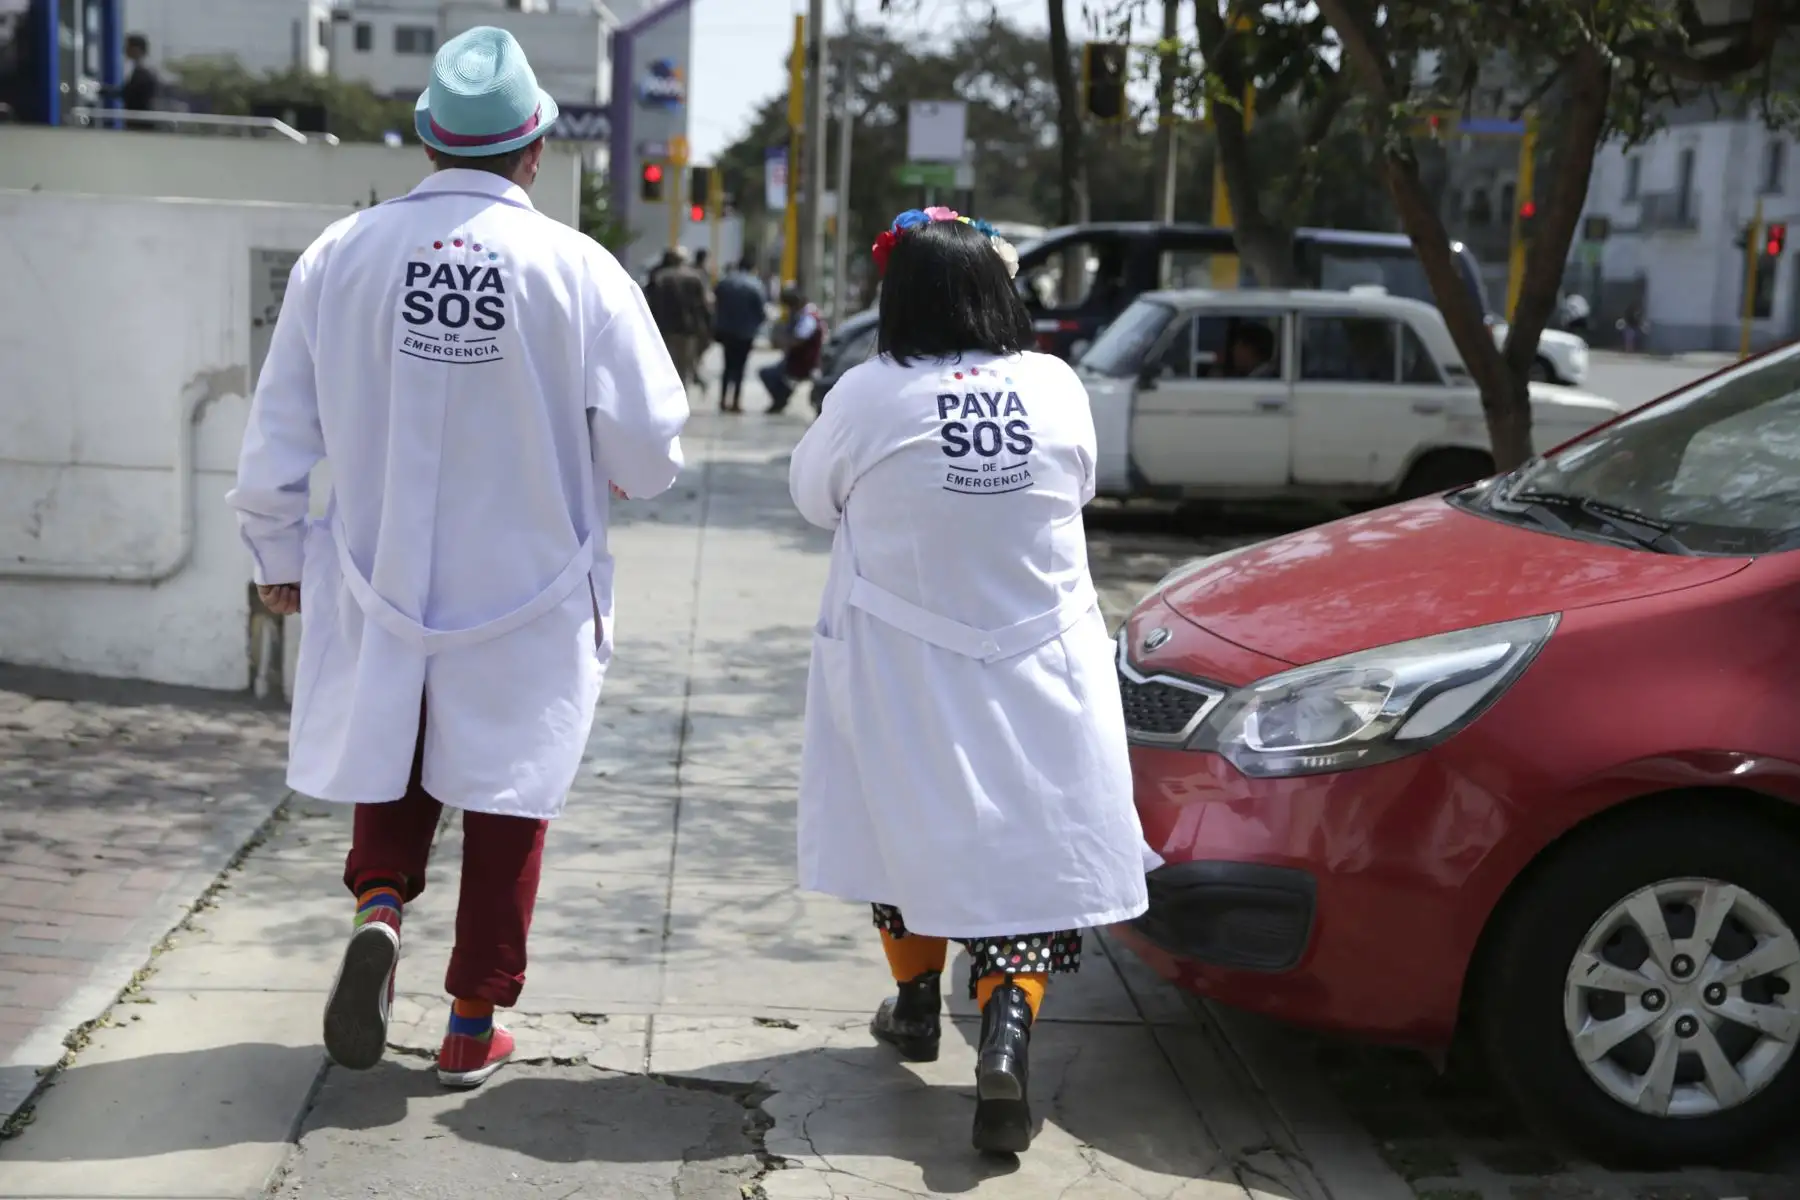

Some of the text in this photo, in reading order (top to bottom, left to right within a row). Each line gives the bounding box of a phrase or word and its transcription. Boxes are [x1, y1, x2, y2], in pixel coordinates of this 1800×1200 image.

[405, 261, 505, 294] PAYA
[402, 290, 505, 331] SOS
[403, 336, 500, 357] EMERGENCIA
[444, 333, 460, 342] DE
[936, 391, 1028, 420] PAYA
[940, 419, 1033, 458] SOS
[946, 469, 1032, 487] EMERGENCIA
[982, 463, 997, 472] DE
